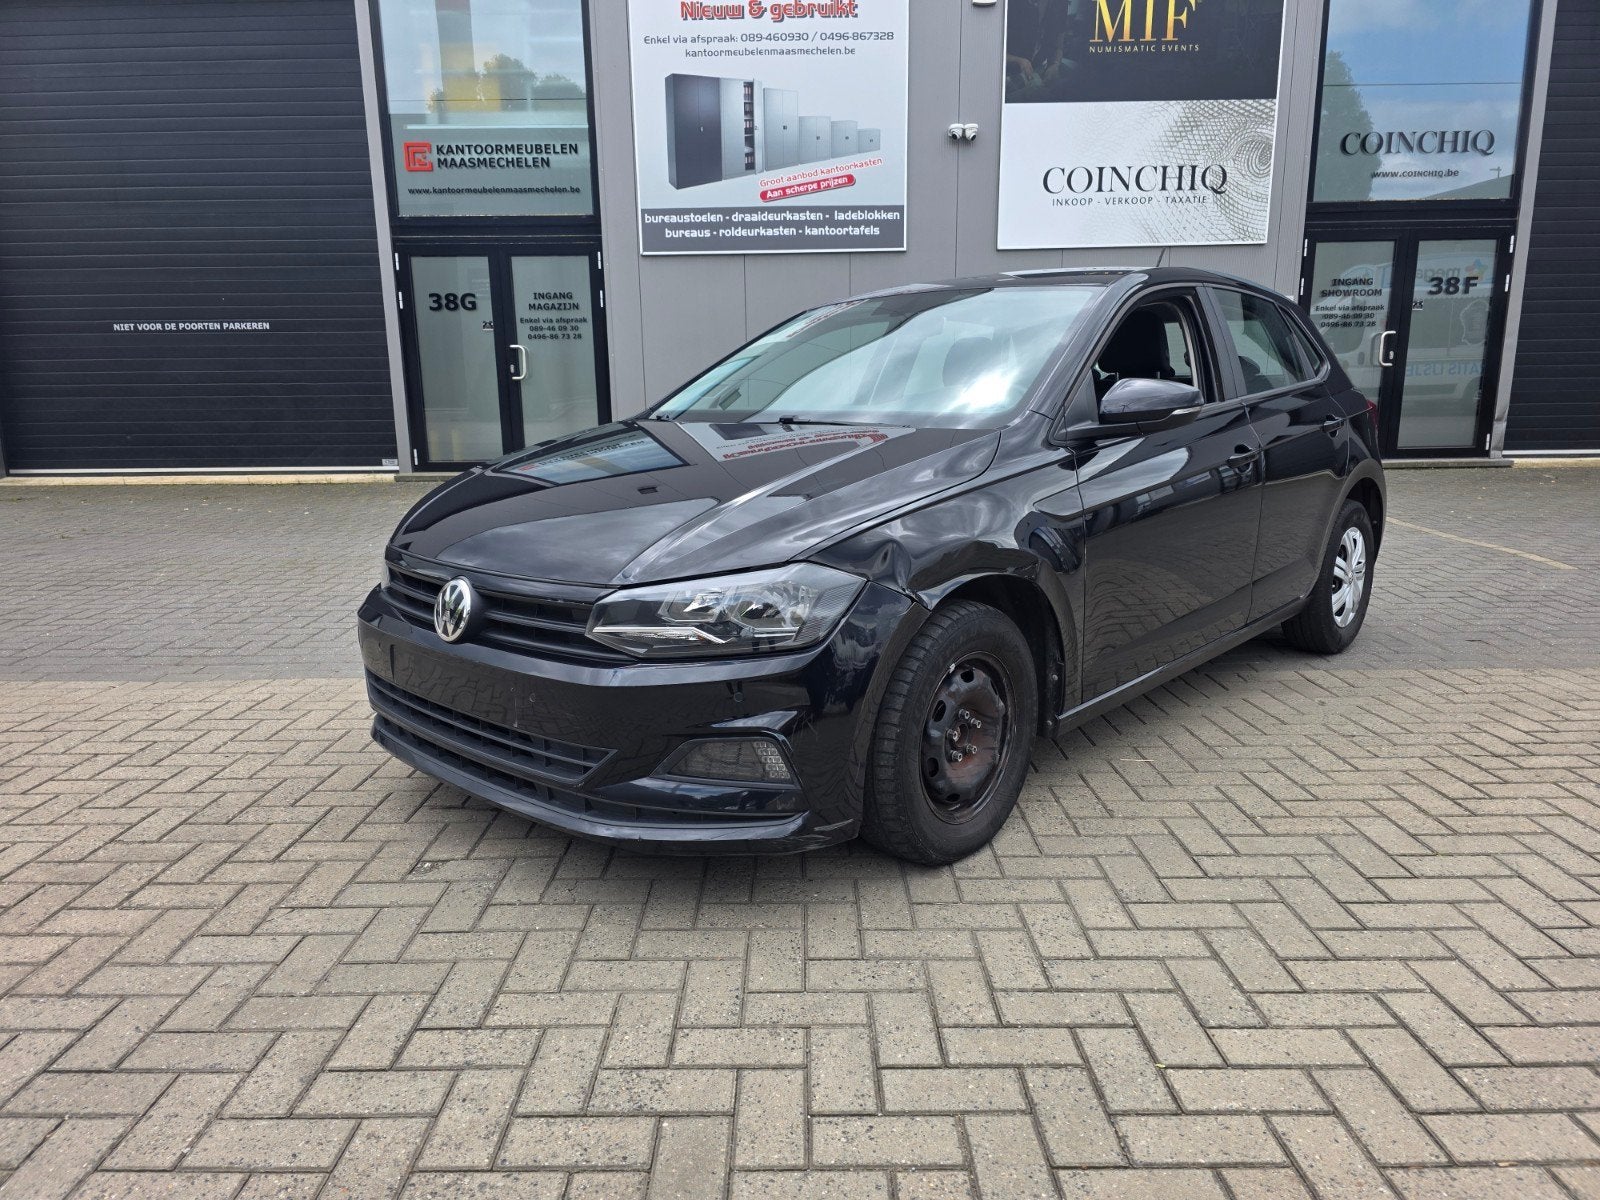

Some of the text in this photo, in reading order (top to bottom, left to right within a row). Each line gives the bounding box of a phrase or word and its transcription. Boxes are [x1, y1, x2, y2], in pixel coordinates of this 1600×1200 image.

[680, 0, 858, 22] Nieuw & gebruikt
[644, 31, 894, 45] Enkel via afspraak: 089-460930 / 0496-867328
[685, 46, 856, 58] kantoormeubelenmaasmechelen.be
[1089, 44, 1200, 53] NUMISMATIC EVENTS
[1340, 129, 1495, 156] COINCHIQ
[435, 143, 578, 155] KANTOORMEUBELEN
[437, 156, 551, 169] MAASMECHELEN
[760, 158, 883, 188] Groot aanbod kantoorkasten
[1042, 164, 1228, 195] COINCHIQ
[407, 185, 581, 196] www.kantoormeubelenmaasmechelen.be
[766, 176, 848, 199] Aan scherpe prijzen
[1052, 197, 1094, 207] INKOOP
[1104, 196, 1153, 206] VERKOOP
[1164, 195, 1207, 204] TAXATIE
[644, 212, 723, 223] bureaustoelen
[731, 210, 823, 222] draaideurkasten
[834, 209, 900, 221] ladeblokken
[665, 228, 711, 238] bureaus
[719, 226, 797, 237] roldeurkasten
[805, 225, 880, 236] kantoortafels
[1332, 277, 1374, 287] INGANG
[1429, 276, 1479, 296] 38F
[533, 292, 573, 300] INGANG
[1320, 288, 1382, 297] SHOWROOM
[428, 292, 477, 312] 38G
[528, 302, 580, 311] MAGAZIJN
[1351, 304, 1385, 313] afspraak
[113, 323, 135, 331] NIET
[137, 323, 163, 331] VOOR
[178, 322, 221, 330] POORTEN
[223, 322, 270, 330] PARKEREN
[555, 316, 588, 325] afspraak
